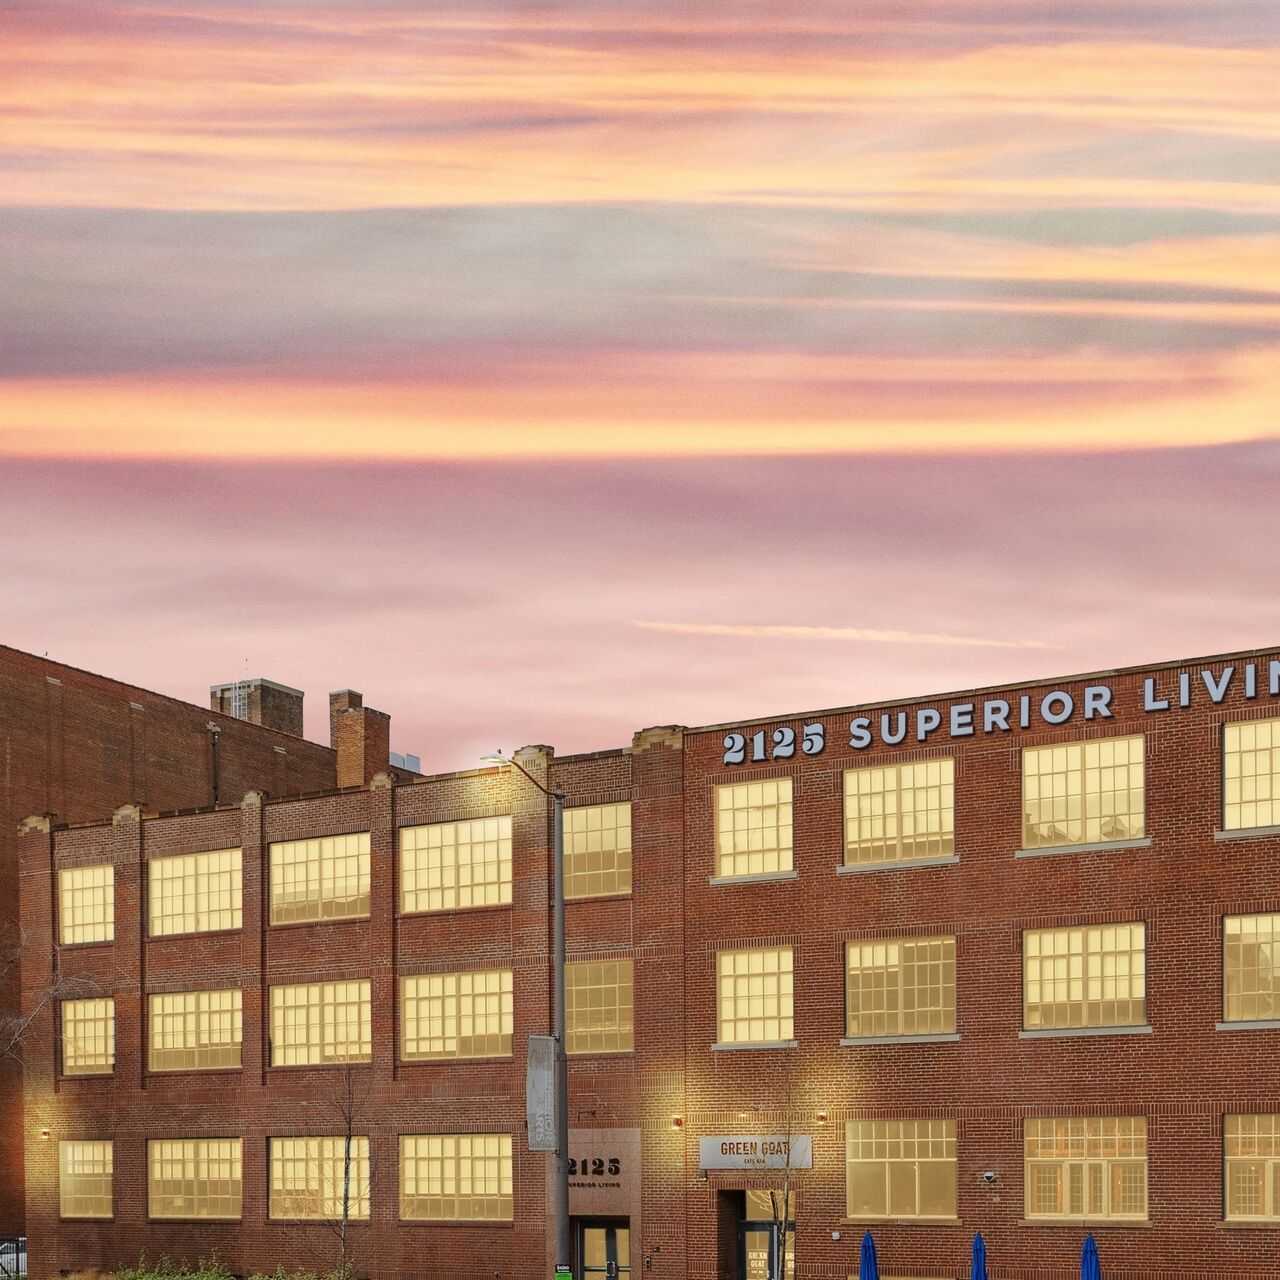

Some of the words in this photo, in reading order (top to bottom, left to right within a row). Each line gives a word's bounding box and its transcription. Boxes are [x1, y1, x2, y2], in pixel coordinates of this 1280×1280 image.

[722, 723, 825, 764] 2125
[848, 685, 1114, 749] SUPERIOR
[721, 1142, 757, 1155] GREEN
[762, 1142, 789, 1155] GOAT
[568, 1157, 620, 1176] 2125
